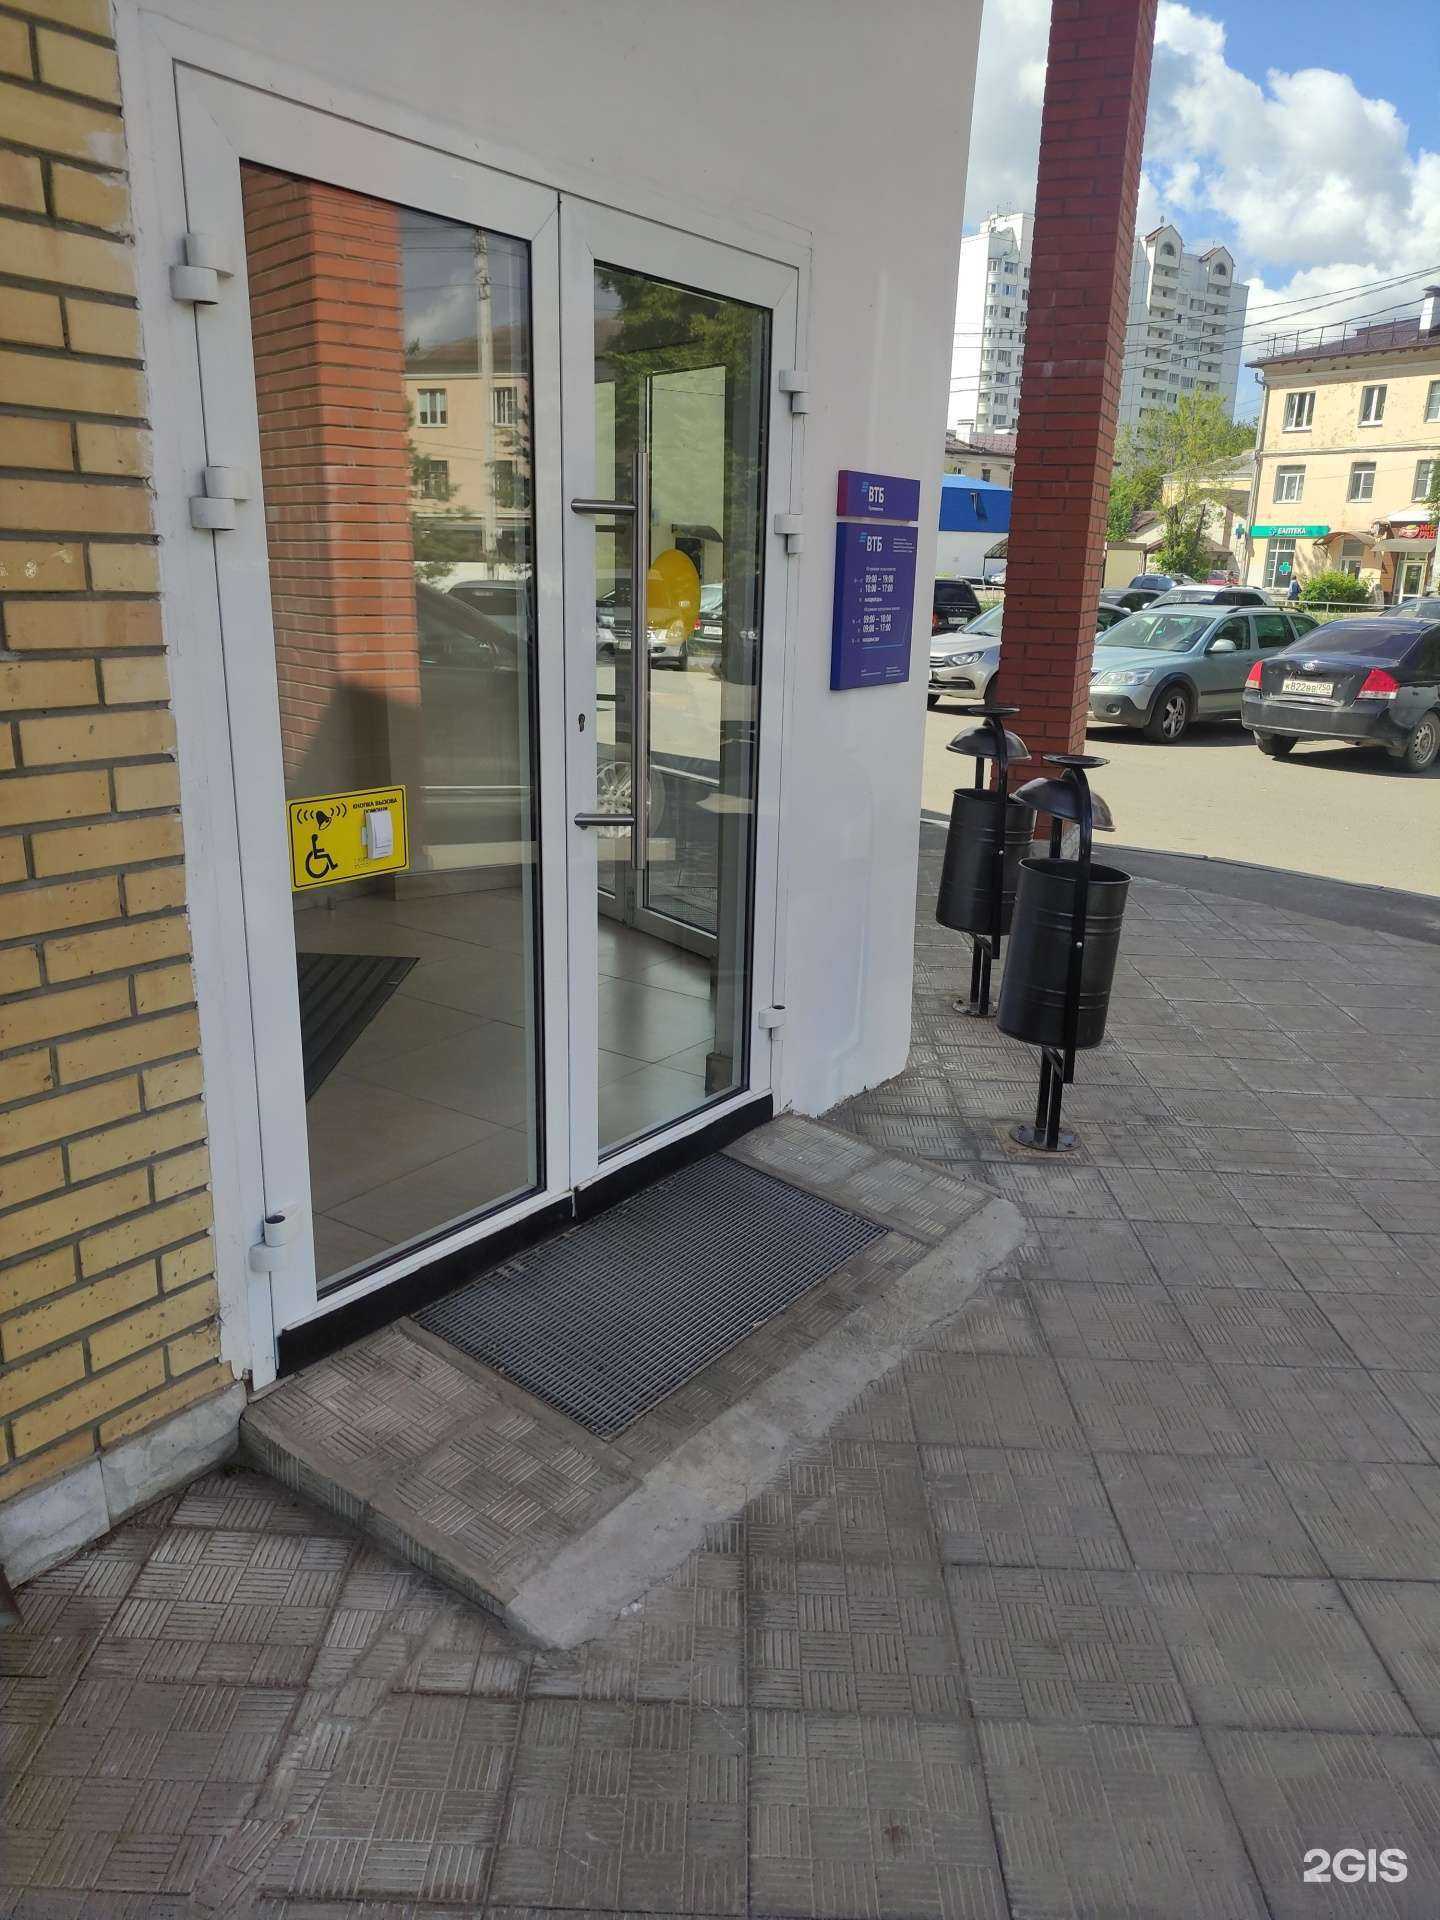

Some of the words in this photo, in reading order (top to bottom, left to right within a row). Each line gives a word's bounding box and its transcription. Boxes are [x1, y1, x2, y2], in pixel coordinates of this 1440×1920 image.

[868, 486, 884, 503] ВТБ
[866, 536, 883, 552] ВТБ
[882, 583, 894, 592] 17:00
[880, 623, 891, 632] 17:00
